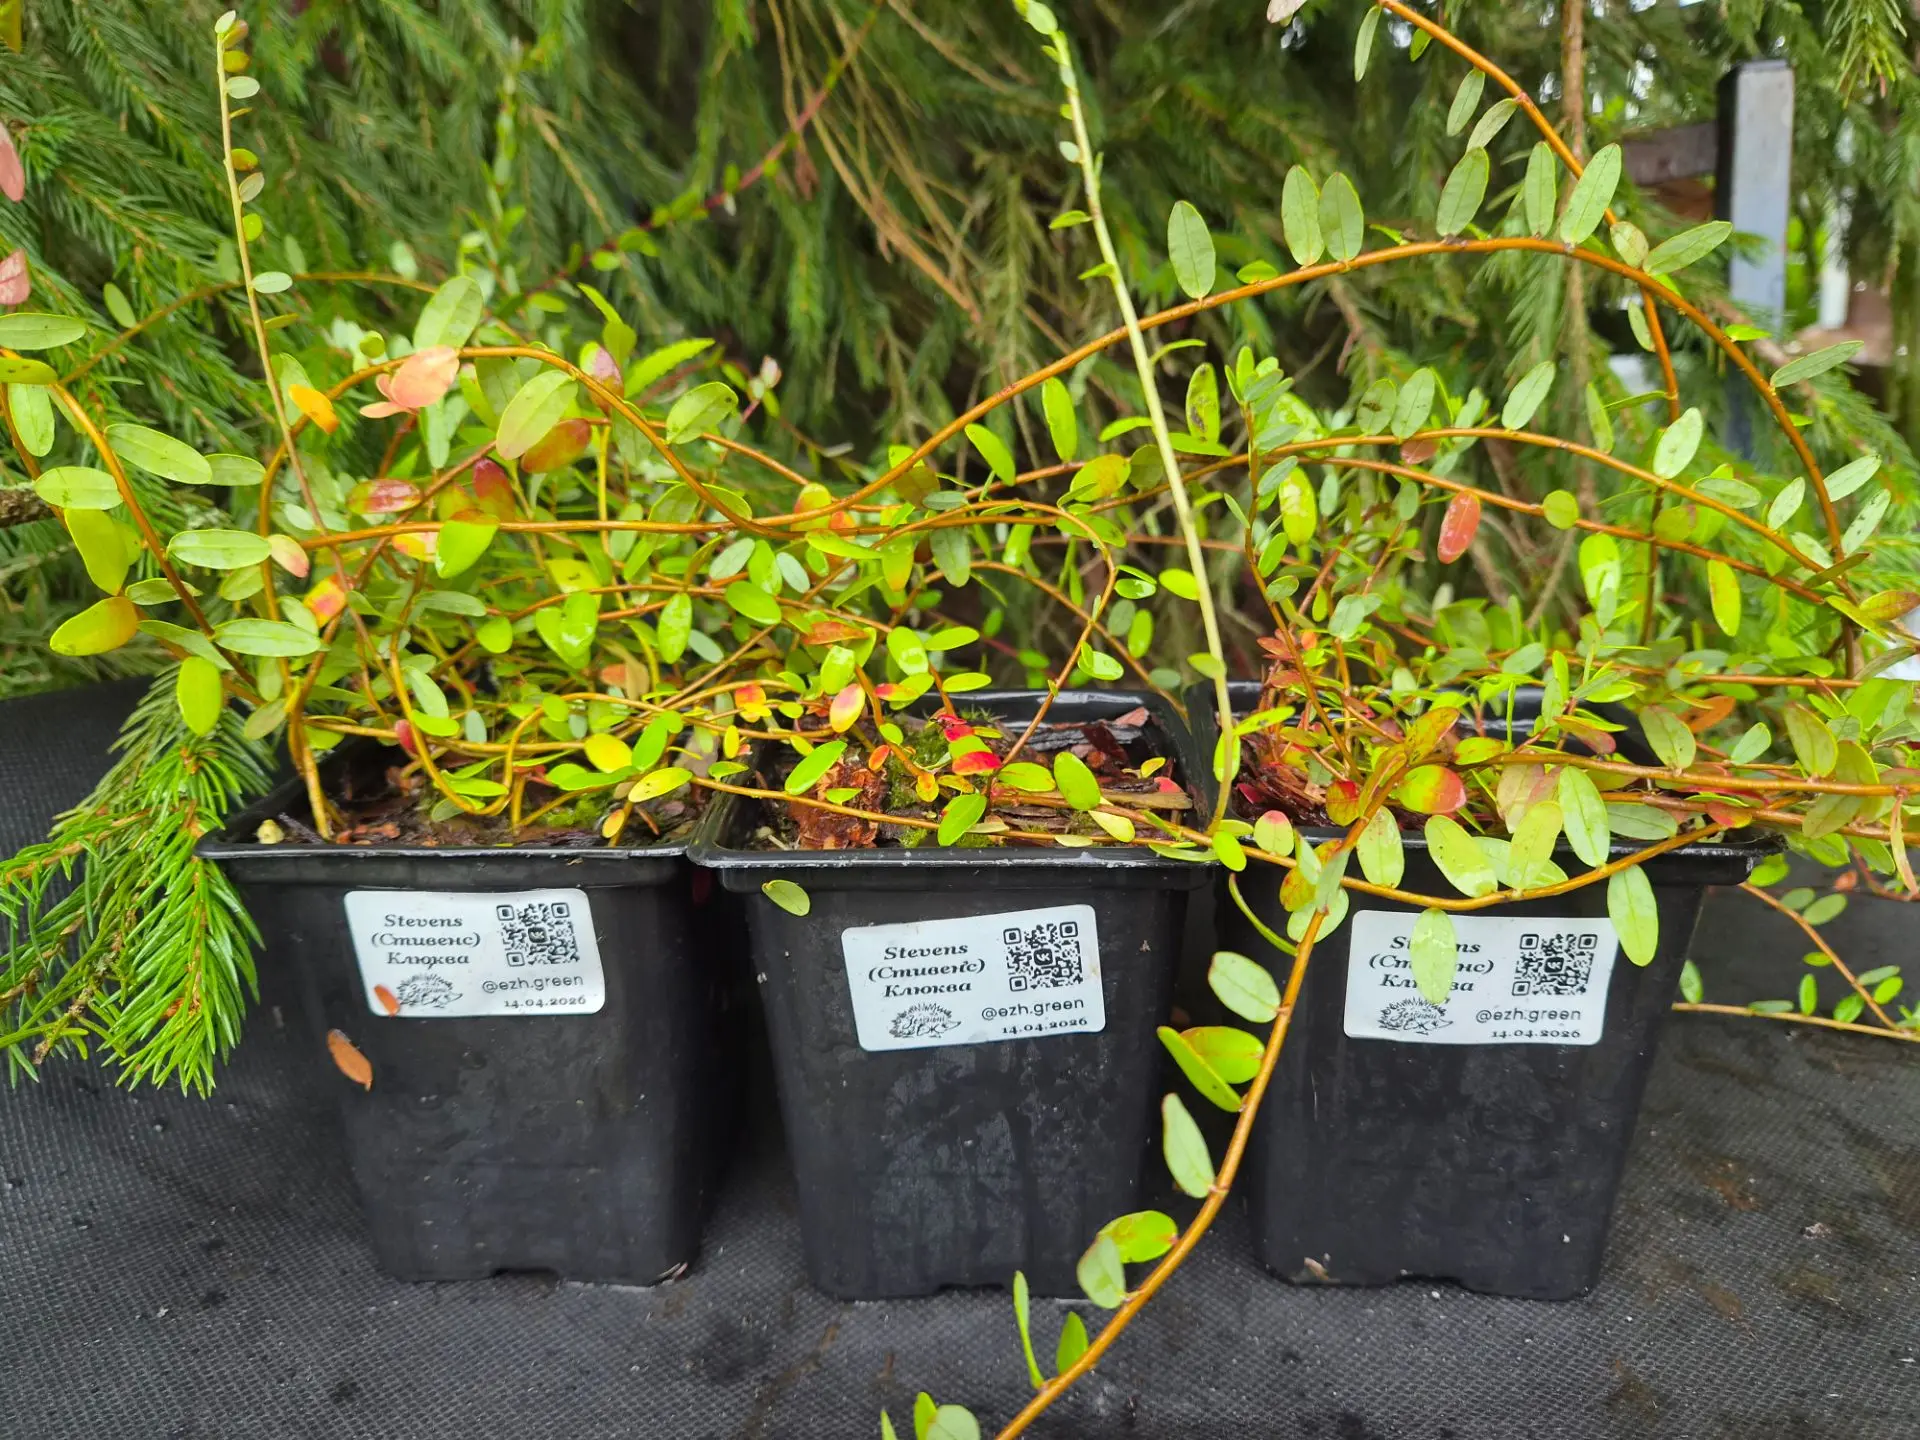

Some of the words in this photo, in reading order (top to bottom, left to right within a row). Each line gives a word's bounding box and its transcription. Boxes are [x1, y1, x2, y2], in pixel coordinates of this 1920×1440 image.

[384, 914, 463, 927] Stevens
[371, 931, 481, 948] (Стивенс)
[386, 951, 470, 965] Клюква
[884, 944, 969, 960] Stevens
[868, 958, 986, 982] (Стивенс)
[1368, 953, 1495, 975] (Стнс)
[482, 975, 584, 994] @ezh.green
[883, 982, 972, 998] Клюква
[504, 995, 587, 1009] 14.04.2026
[981, 999, 1084, 1021] @ezh.green
[1475, 1007, 1581, 1023] @ezh.green
[1002, 1017, 1088, 1034] 14.04.2026
[1491, 1029, 1581, 1039] 14.04.2026
